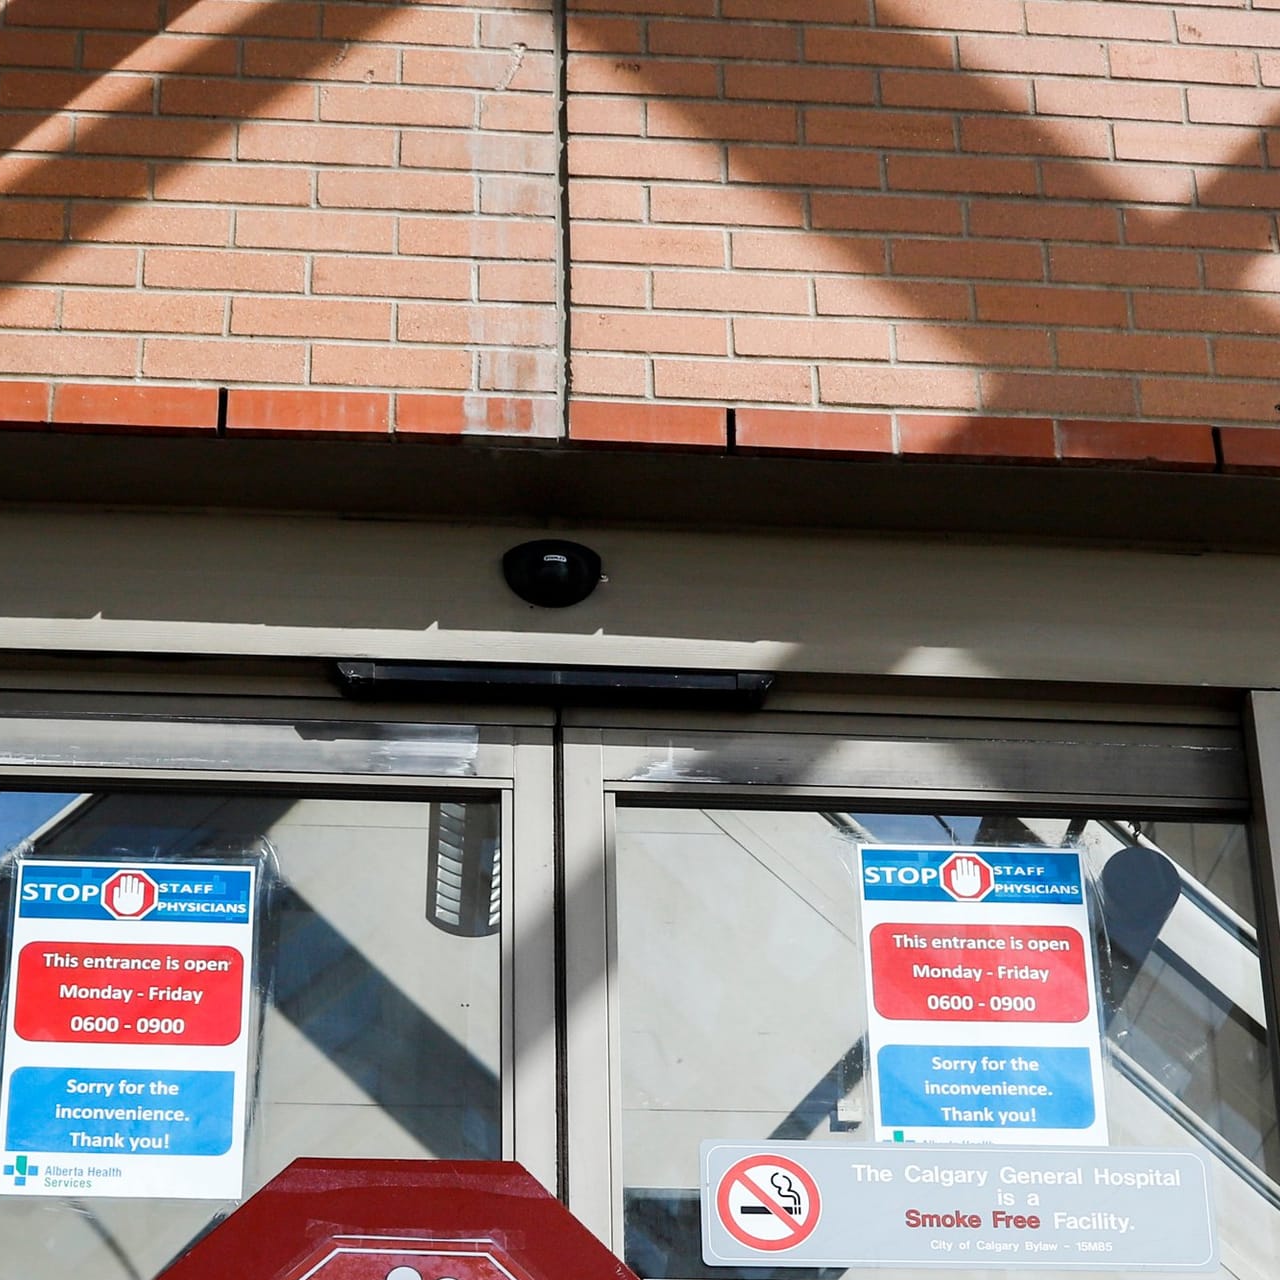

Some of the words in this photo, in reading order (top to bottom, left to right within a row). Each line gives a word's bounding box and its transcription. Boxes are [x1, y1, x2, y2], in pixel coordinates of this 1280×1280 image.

[865, 866, 936, 884] STOP
[994, 866, 1045, 876] STAFF
[22, 883, 99, 901] STOP
[159, 883, 213, 894] STAFF
[994, 884, 1079, 894] PHYSICIANS
[157, 901, 247, 913] PHYSICIANS
[893, 934, 927, 948] This
[932, 937, 1005, 950] entrance
[1010, 936, 1023, 949] is
[1028, 939, 1070, 952] open
[43, 953, 78, 968] This
[83, 956, 161, 970] entrance
[166, 956, 180, 970] is
[184, 959, 229, 973] open
[912, 964, 982, 981] Monday
[998, 965, 1049, 982] Friday
[59, 984, 133, 1003] Monday
[148, 986, 203, 1004] Friday
[927, 995, 973, 1010] 0600
[990, 996, 1036, 1011] 0900
[70, 1016, 119, 1032] 0600
[136, 1018, 185, 1034] 0900
[932, 1056, 976, 1074] Sorry
[981, 1056, 1006, 1071] for
[1012, 1057, 1039, 1072] the
[66, 1079, 114, 1097] Sorry
[119, 1080, 145, 1095] for
[149, 1081, 179, 1096] the
[924, 1081, 1053, 1096] inconvenience.
[55, 1104, 190, 1122] inconvenience.
[941, 1107, 994, 1122] Thank
[998, 1108, 1036, 1125] you!
[70, 1132, 124, 1148] Thank
[129, 1134, 170, 1152] you!
[45, 1165, 83, 1177] Alberta
[88, 1166, 122, 1177] Health
[851, 1164, 893, 1183] The
[904, 1165, 988, 1187] Calgary
[999, 1166, 1082, 1185] General
[1094, 1167, 1180, 1188] Hospital
[44, 1177, 92, 1189] Services
[997, 1188, 1015, 1206] is
[1027, 1192, 1040, 1206] a
[904, 1209, 982, 1229] Smoke
[992, 1210, 1041, 1229] Free
[1054, 1212, 1135, 1233] Facility.
[930, 1239, 952, 1252] City
[959, 1240, 971, 1251] of
[976, 1240, 1019, 1253] Calgary
[1025, 1240, 1058, 1253] Bylaw
